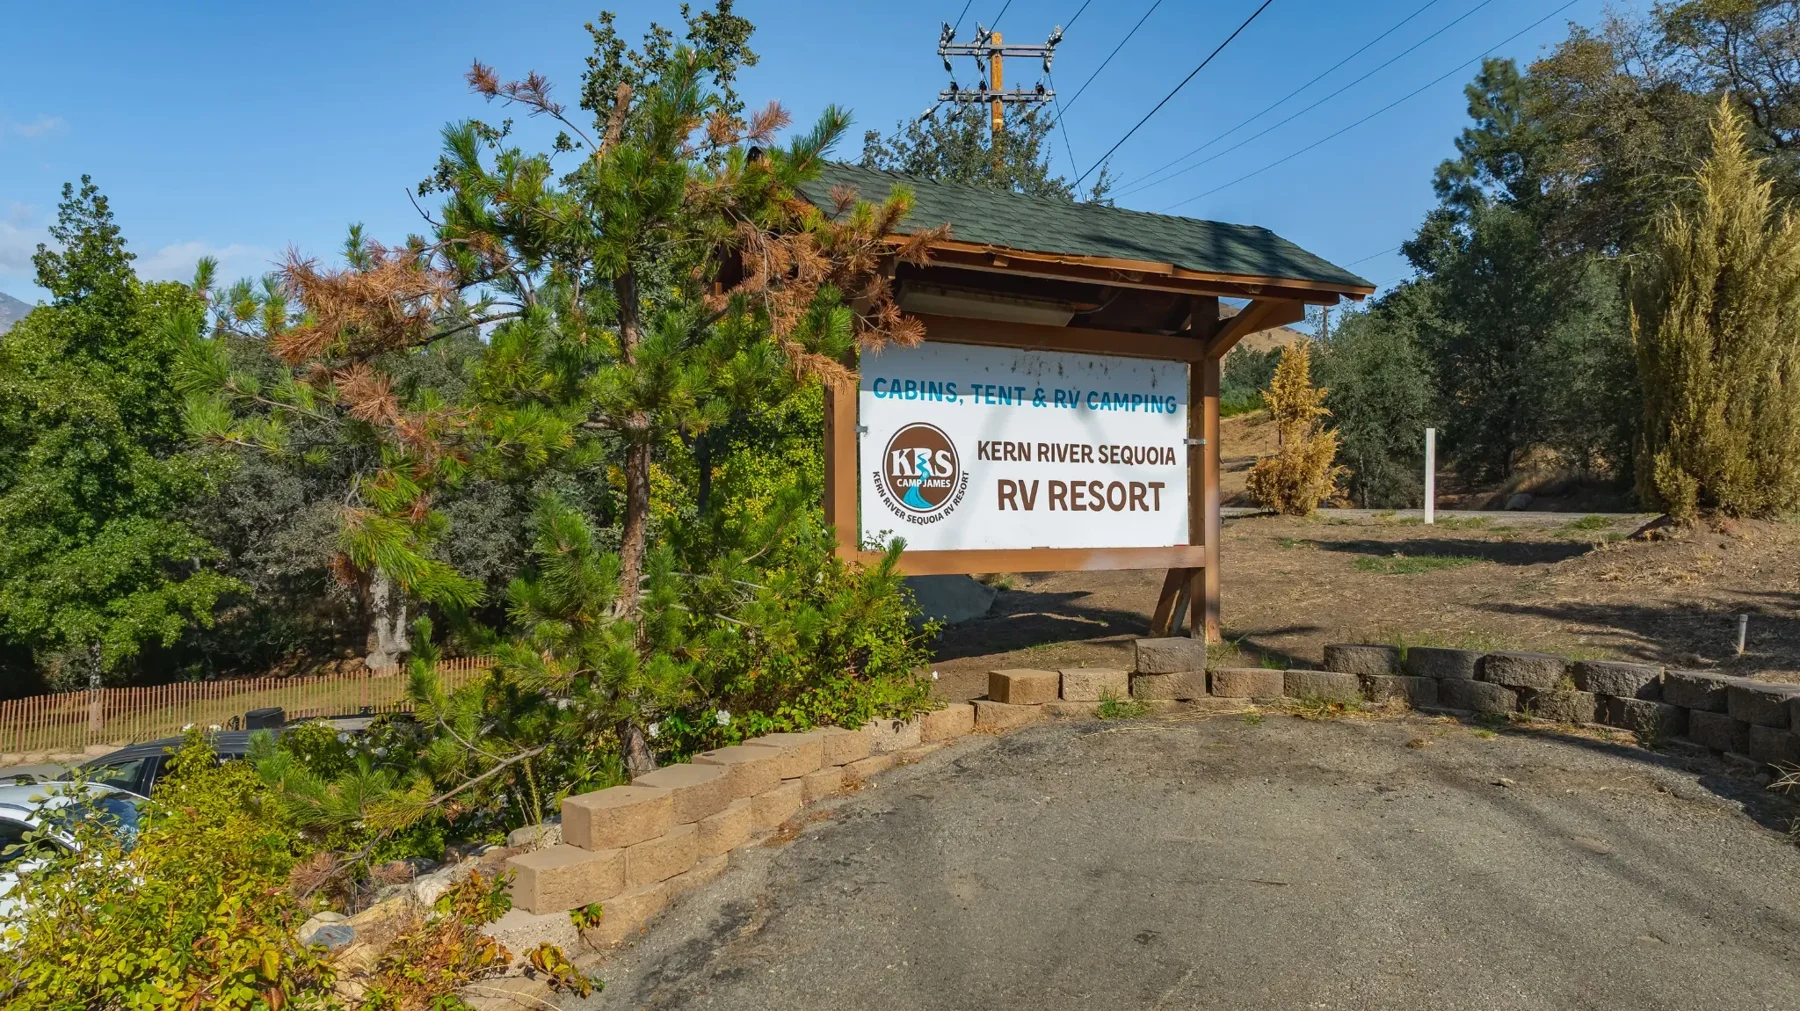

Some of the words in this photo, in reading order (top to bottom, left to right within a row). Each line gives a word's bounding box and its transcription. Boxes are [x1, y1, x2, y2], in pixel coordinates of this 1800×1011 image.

[873, 377, 964, 405] CABINS,
[970, 383, 1026, 406] TENT
[1032, 387, 1047, 408] &
[1054, 389, 1081, 409] RV
[1086, 390, 1177, 414] CAMPING
[891, 447, 953, 478] KRS
[977, 440, 1031, 462] KERN
[1037, 442, 1094, 464] RIVER
[1098, 444, 1176, 466] SEQUOIA
[872, 471, 886, 498] KERN
[883, 496, 906, 520] RIVER
[906, 512, 944, 526] SEQUOIA
[943, 504, 955, 516] RV
[952, 470, 969, 506] RESORT
[896, 478, 921, 487] CAMP
[922, 479, 951, 488] JAMES
[997, 479, 1039, 511] RV
[1048, 480, 1165, 512] RESORT
